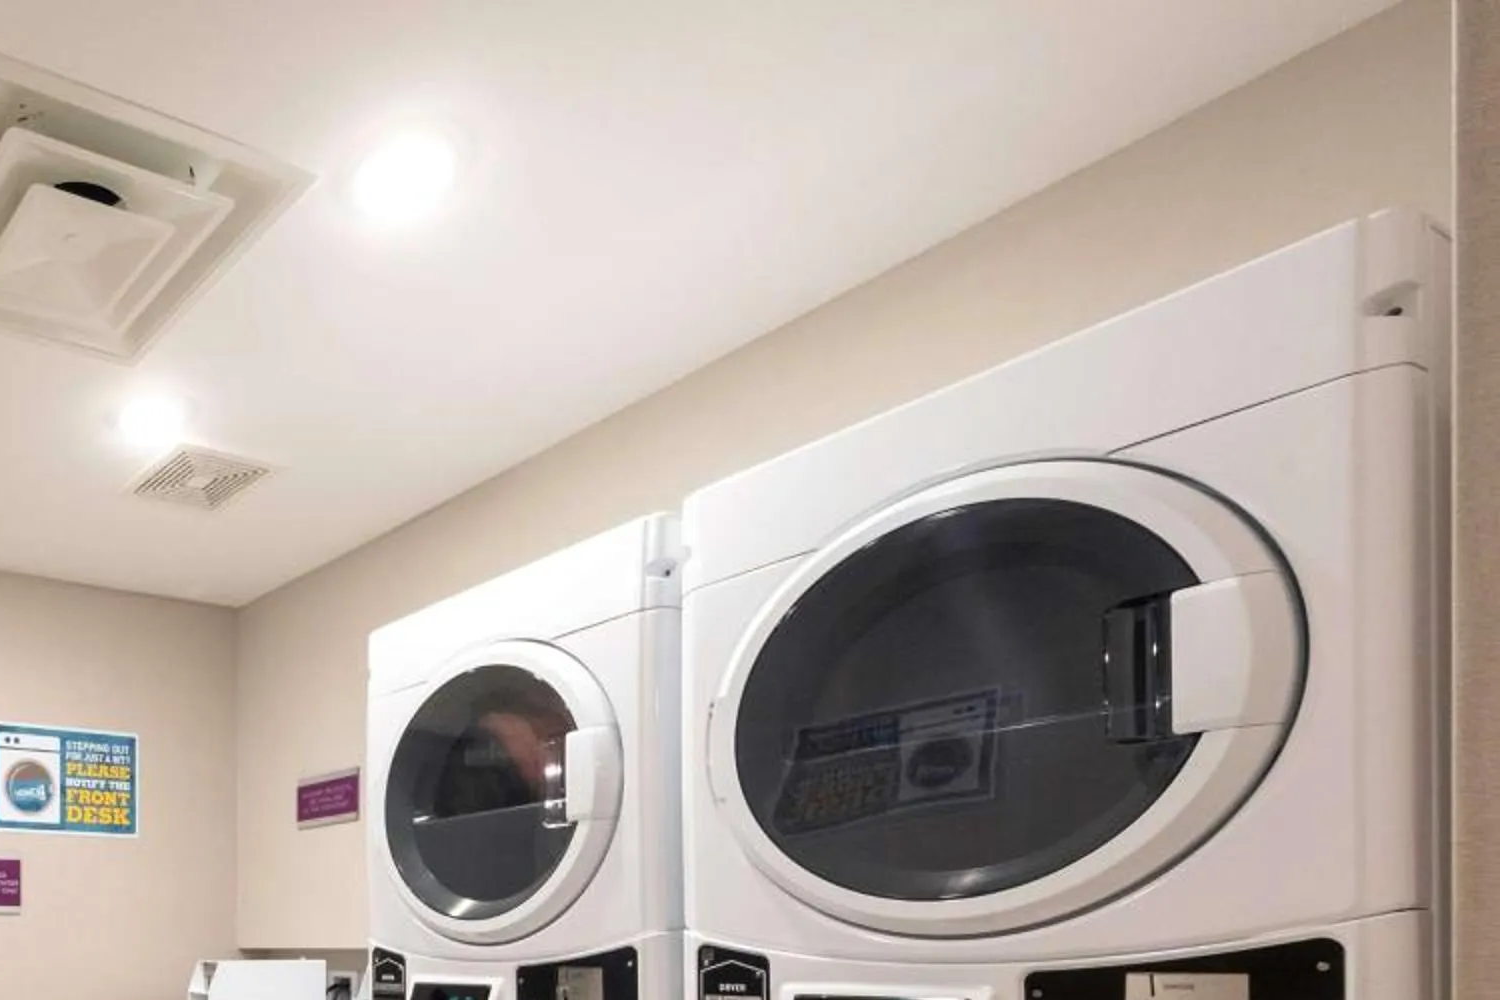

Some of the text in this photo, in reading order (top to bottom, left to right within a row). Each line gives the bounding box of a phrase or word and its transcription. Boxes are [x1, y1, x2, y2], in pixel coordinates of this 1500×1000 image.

[66, 740, 129, 755] STEPPING OUT
[67, 761, 131, 780] PLEASE
[66, 777, 131, 791] NOTIFY THE
[67, 787, 131, 806] FRONT
[67, 805, 132, 825] DESK
